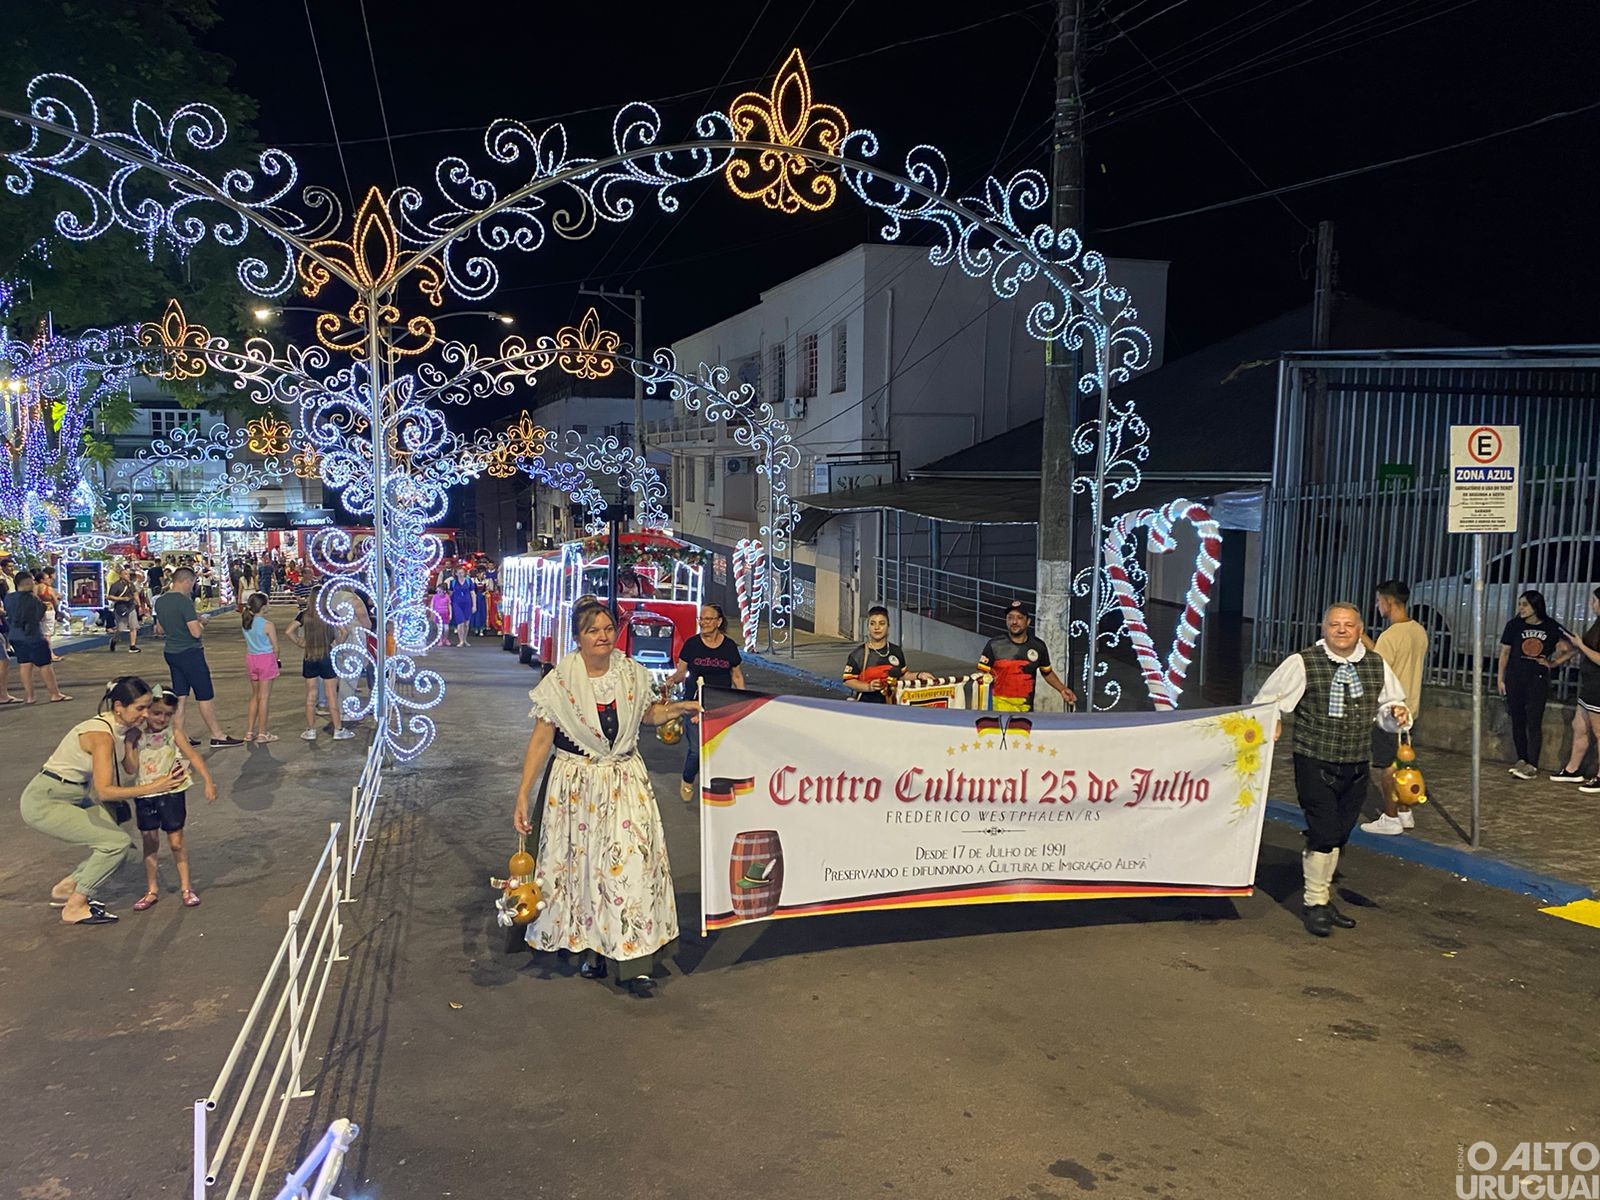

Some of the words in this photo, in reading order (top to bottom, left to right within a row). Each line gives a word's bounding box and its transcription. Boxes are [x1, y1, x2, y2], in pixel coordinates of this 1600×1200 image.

[1478, 435, 1492, 455] E
[1456, 469, 1485, 480] ZONA
[1487, 469, 1513, 480] AZUL
[1521, 631, 1547, 640] LEGEND
[769, 765, 882, 805] Centro
[895, 767, 1029, 803] Cultural
[1039, 770, 1078, 804] 25
[1088, 770, 1119, 804] de
[1123, 768, 1210, 809] Julho
[886, 810, 970, 823] FREDERICO
[978, 808, 1102, 822] WESTPHALEN/RS
[915, 846, 948, 860] DESDE
[952, 845, 966, 859] 17
[968, 848, 982, 859] DE
[986, 844, 1021, 858] JULHO
[1024, 847, 1039, 857] DE
[1042, 843, 1066, 857] 1991
[902, 867, 909, 877] E
[912, 864, 974, 877] DIFUNDINDO
[977, 864, 985, 874] A
[988, 860, 1038, 873] CULTURA
[1041, 862, 1056, 872] DE
[1058, 858, 1112, 872] IMIGRAÇÃO
